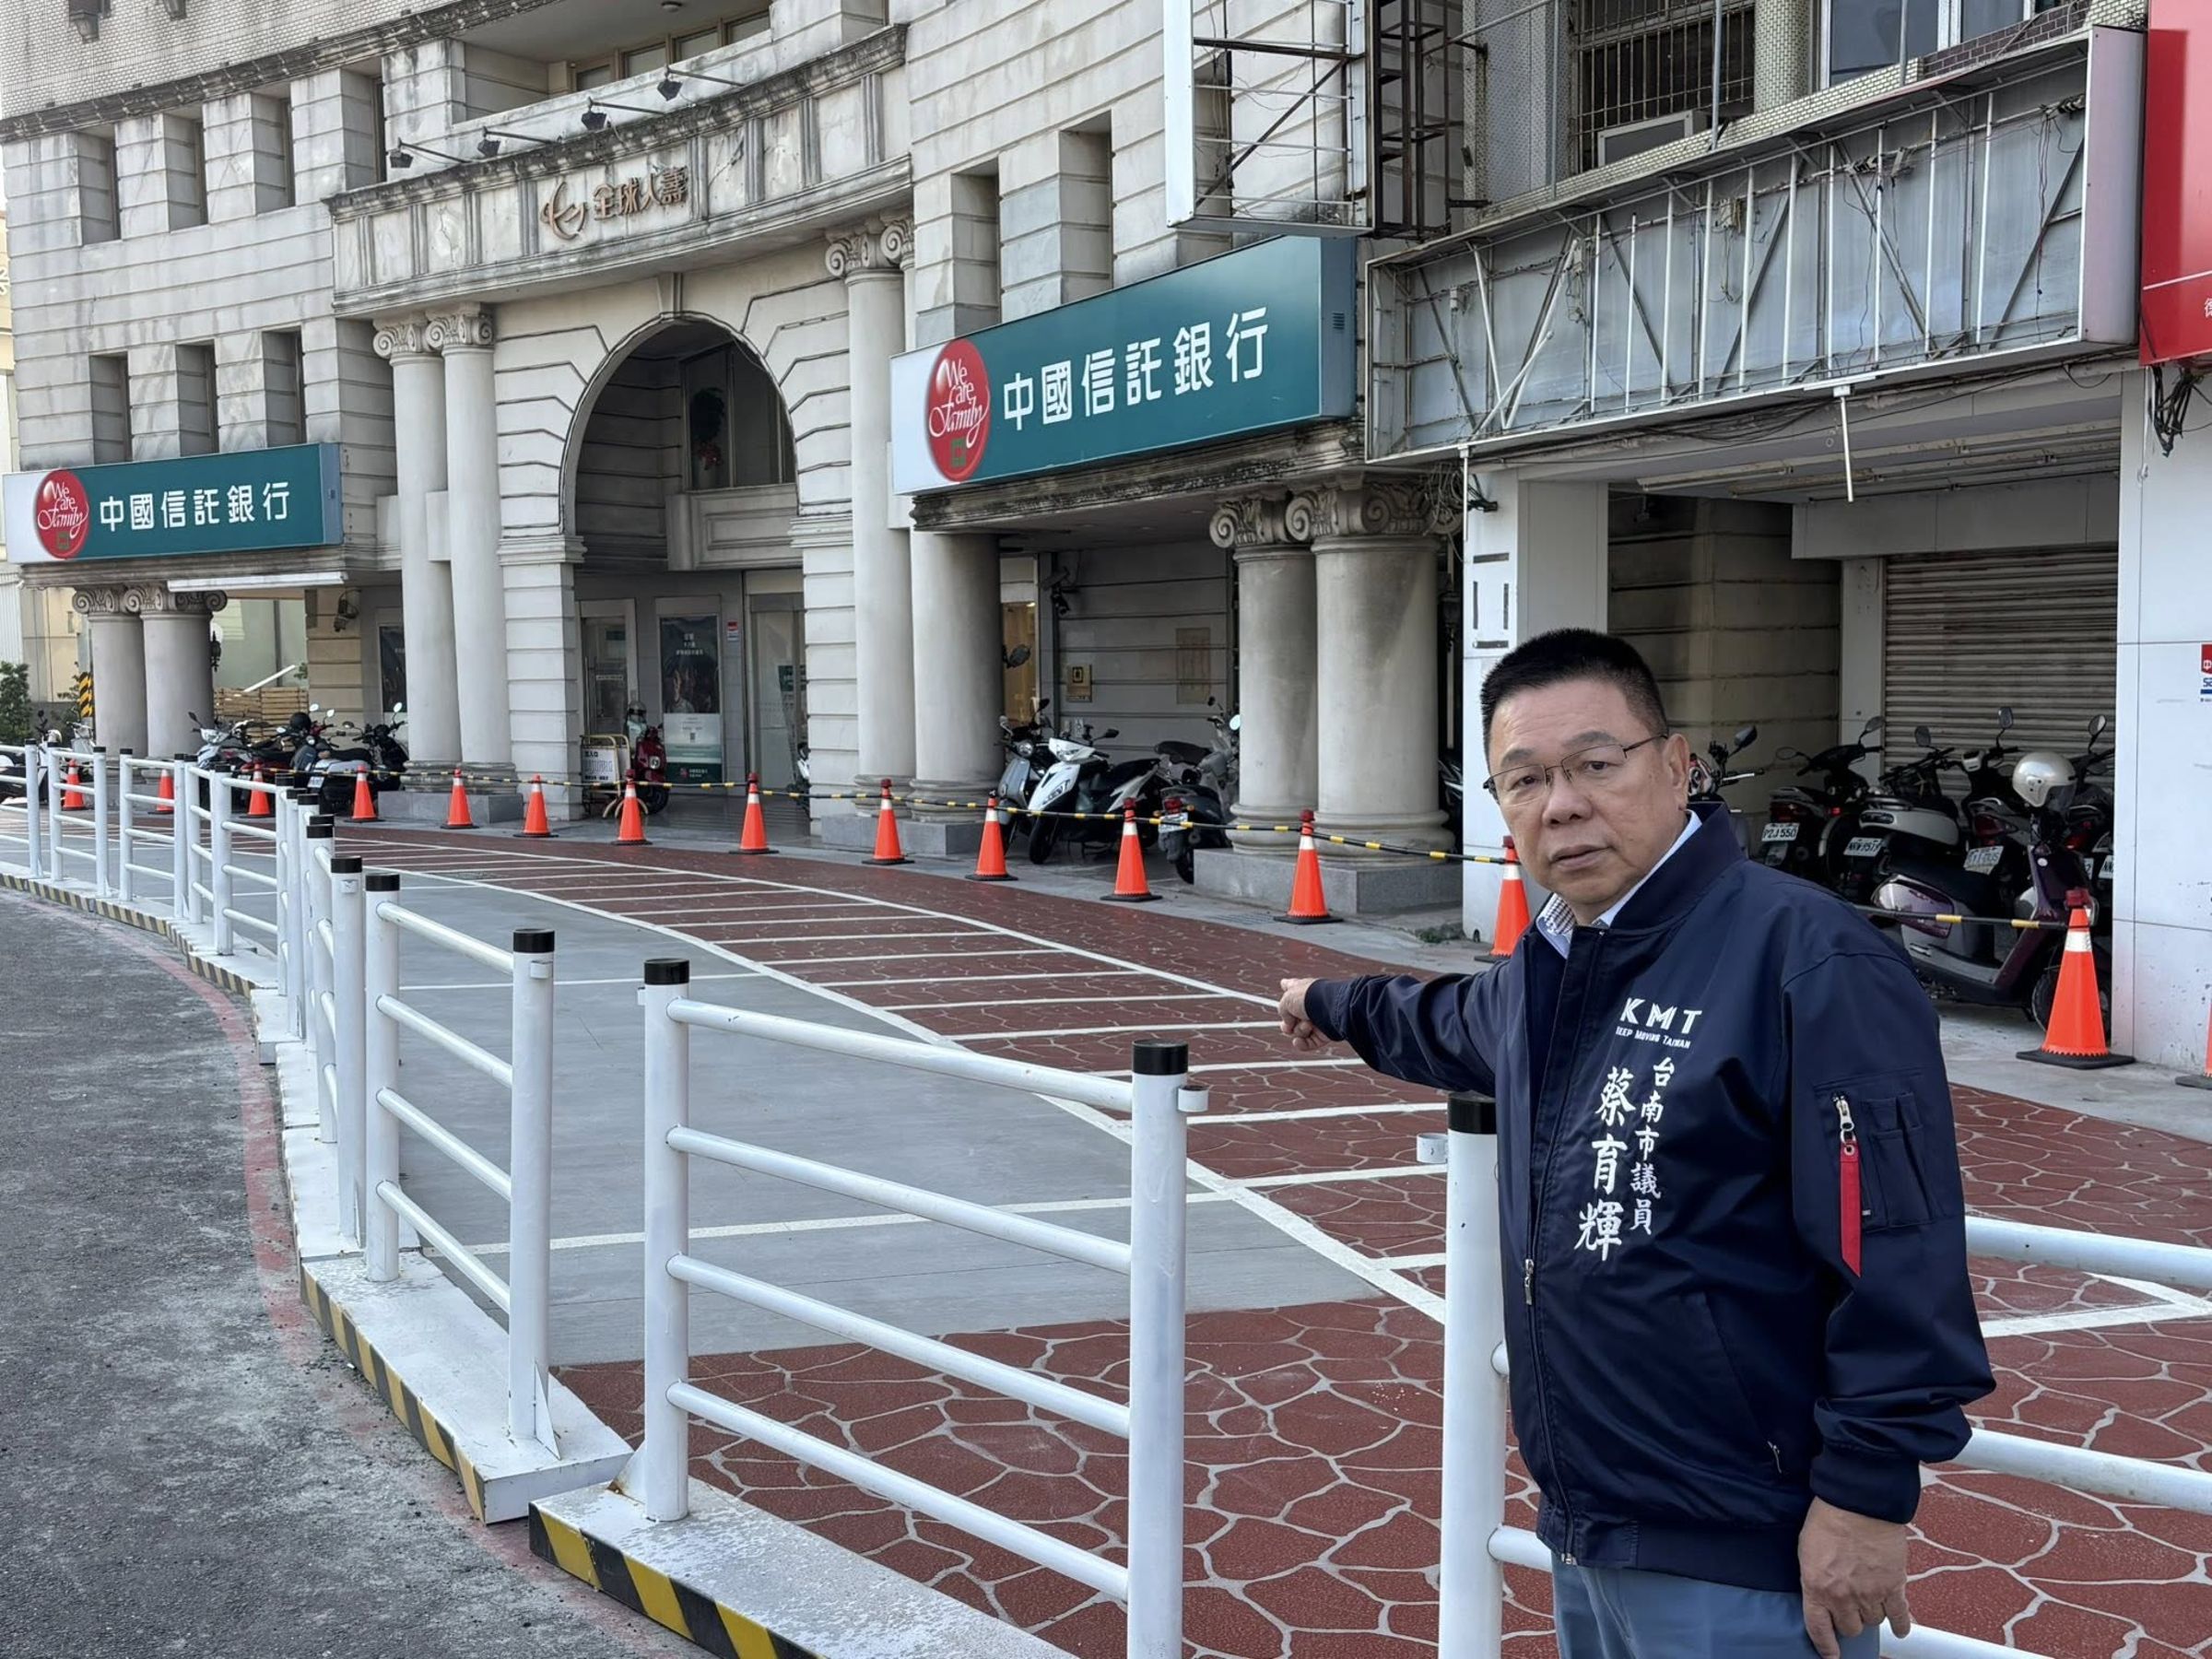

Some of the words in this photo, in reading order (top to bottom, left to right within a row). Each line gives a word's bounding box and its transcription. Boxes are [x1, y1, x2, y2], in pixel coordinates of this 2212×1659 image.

[594, 166, 688, 221] 全球人壽
[936, 359, 968, 387] We
[1003, 307, 1268, 431] 中國信託銀行
[955, 382, 974, 405] are
[929, 385, 991, 448] Family
[43, 480, 70, 500] We
[60, 497, 76, 511] are
[100, 481, 290, 532] 中國信託銀行
[38, 499, 89, 539] Family
[1619, 997, 1703, 1034] KMT
[1663, 1034, 1691, 1049] TAIWAN
[1573, 1065, 1636, 1262] 蔡育輝
[1630, 1056, 1675, 1235] 台南市議員
